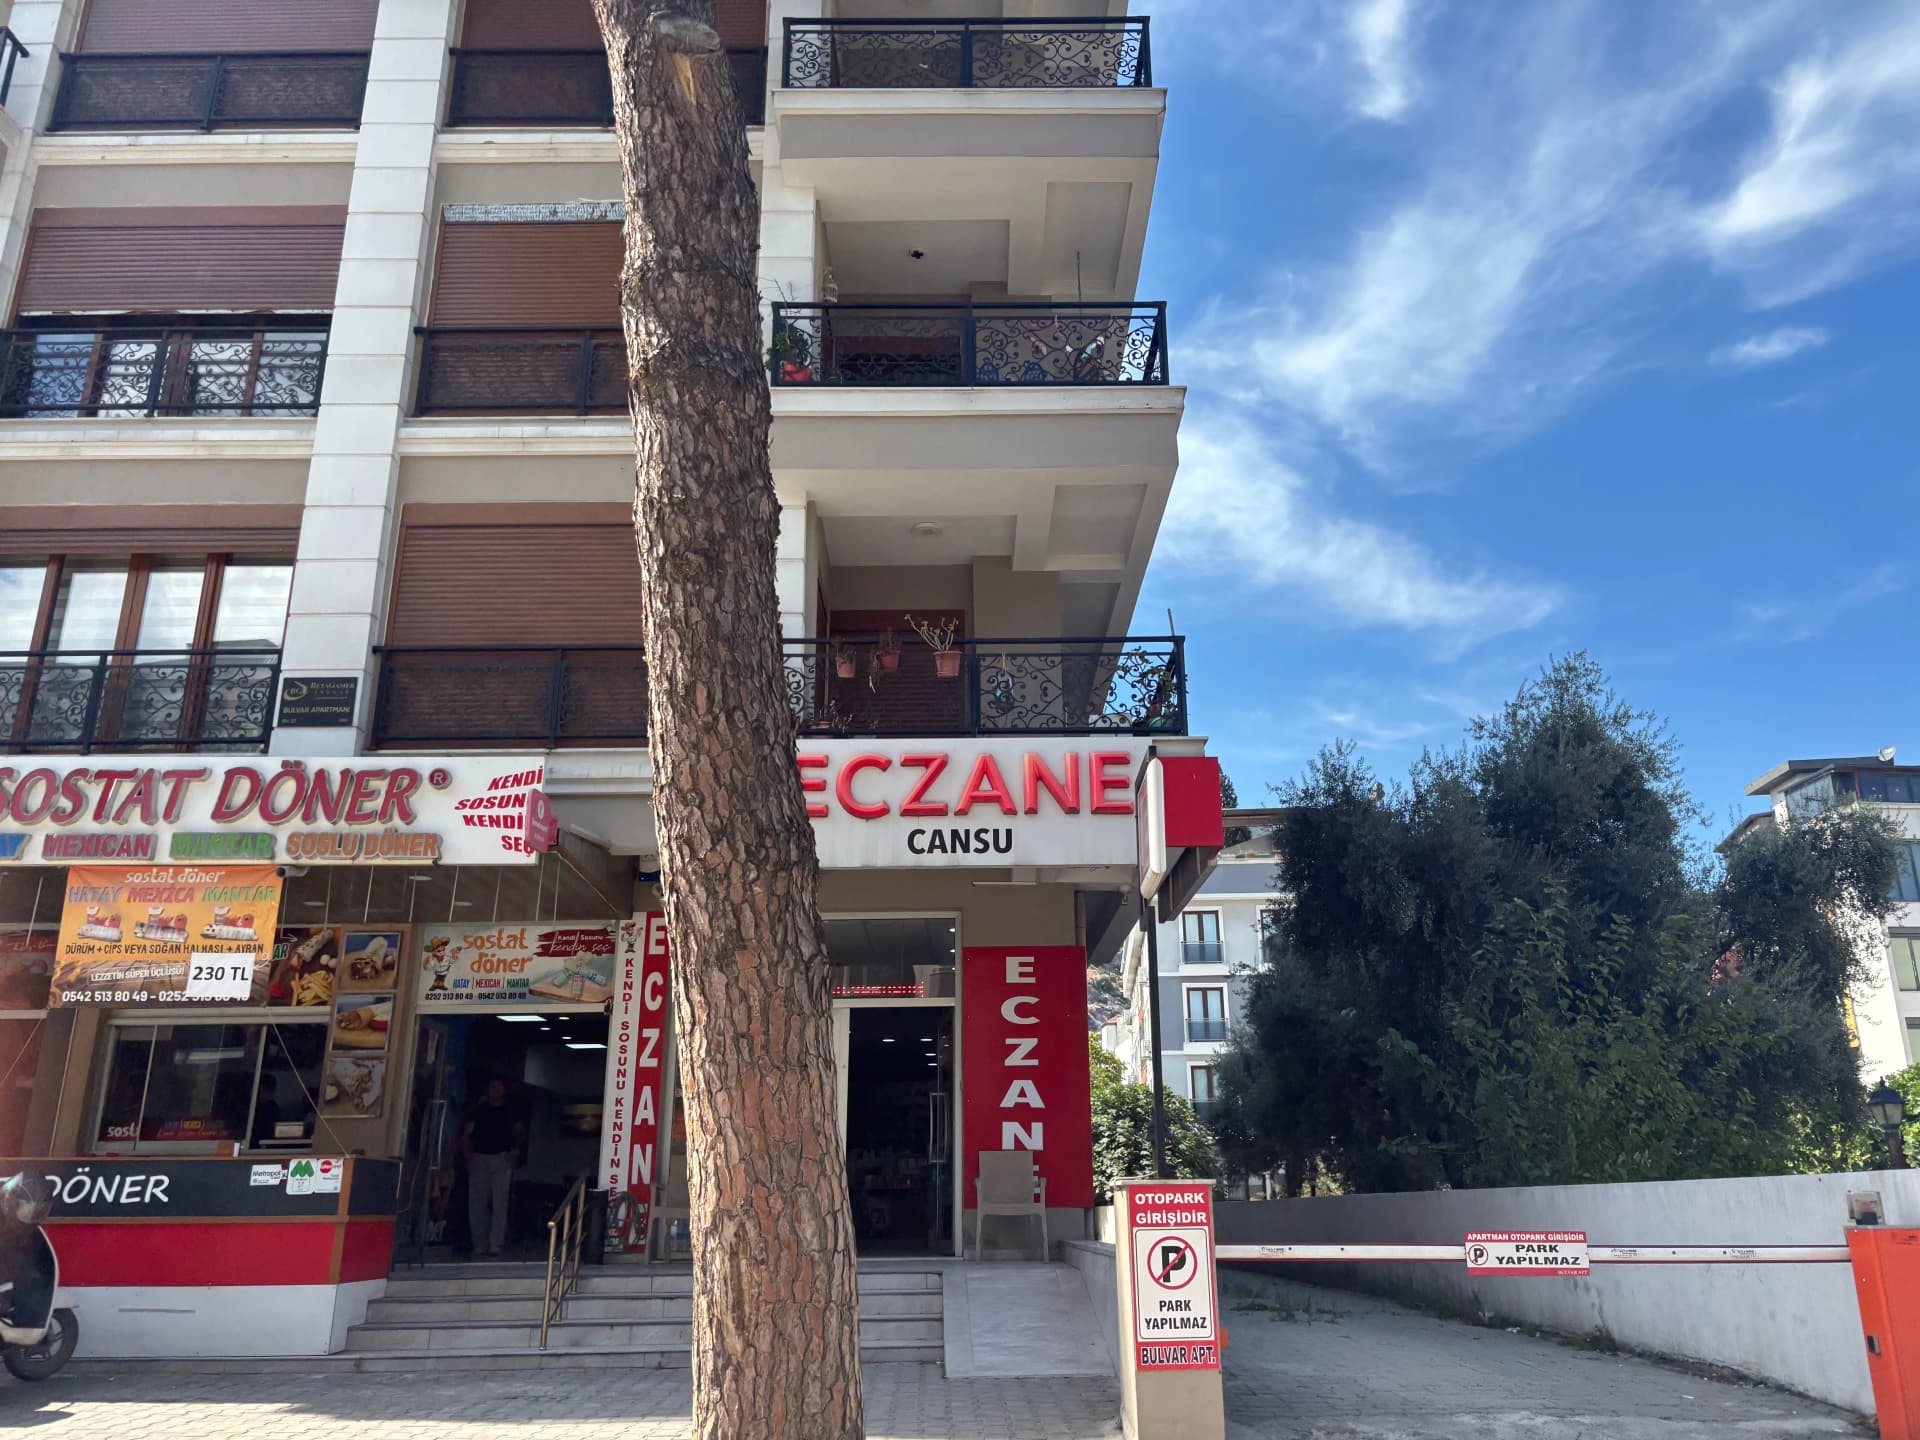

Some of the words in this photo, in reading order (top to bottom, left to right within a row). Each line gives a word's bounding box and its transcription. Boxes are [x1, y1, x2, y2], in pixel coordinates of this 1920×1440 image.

[487, 765, 543, 791] KENDİ
[211, 760, 421, 825] DÖNER
[43, 833, 157, 861] MEXICAN
[170, 832, 276, 861] MANTAR
[286, 832, 364, 860] SOSLU
[363, 828, 443, 860] DÖNER
[907, 828, 1014, 854] CANSU
[124, 869, 175, 883] sostat
[177, 868, 226, 883] döner
[68, 886, 124, 904] HATAY
[201, 886, 276, 904] MANTAR
[463, 928, 528, 950] sostat
[65, 943, 95, 954] DÜRÜM
[103, 943, 122, 954] CİPS
[124, 943, 147, 954] VEYA
[148, 942, 180, 954] SOĞAN
[234, 943, 264, 954] AYRAN
[470, 952, 533, 974] döner
[91, 972, 125, 982] LEZZETİN
[125, 970, 150, 980] SÜPER
[192, 966, 225, 981] 230
[231, 966, 249, 981] TL
[452, 979, 470, 989] HATAY
[476, 979, 501, 989] MEXICAN
[507, 978, 530, 989] MANTAR
[622, 958, 634, 1015] KENDİ
[62, 990, 91, 1002] 0542
[94, 990, 112, 1002] 513
[114, 990, 130, 1002] 80
[132, 990, 148, 1002] 49
[158, 990, 188, 1002] 0252
[616, 1021, 630, 1090] SOSUNU
[1000, 956, 1045, 1203] ECZAN
[107, 1122, 139, 1137] sost
[610, 1097, 624, 1169] KENDİN
[1135, 1192, 1204, 1205] OTOPARK
[1136, 1210, 1207, 1226] GİRİŞİDİR
[1467, 1233, 1508, 1241] APARTMAN
[1510, 1233, 1546, 1241] OTOPARK
[1547, 1232, 1584, 1242] GİRİŞİDİR
[1515, 1244, 1559, 1253] PARK
[1495, 1257, 1581, 1265] YAPILMAZ
[1159, 1300, 1192, 1312] PARK
[1144, 1317, 1207, 1330] YAPILMAZ
[1141, 1346, 1188, 1365] BULVAR
[1190, 1346, 1216, 1364] APT.
